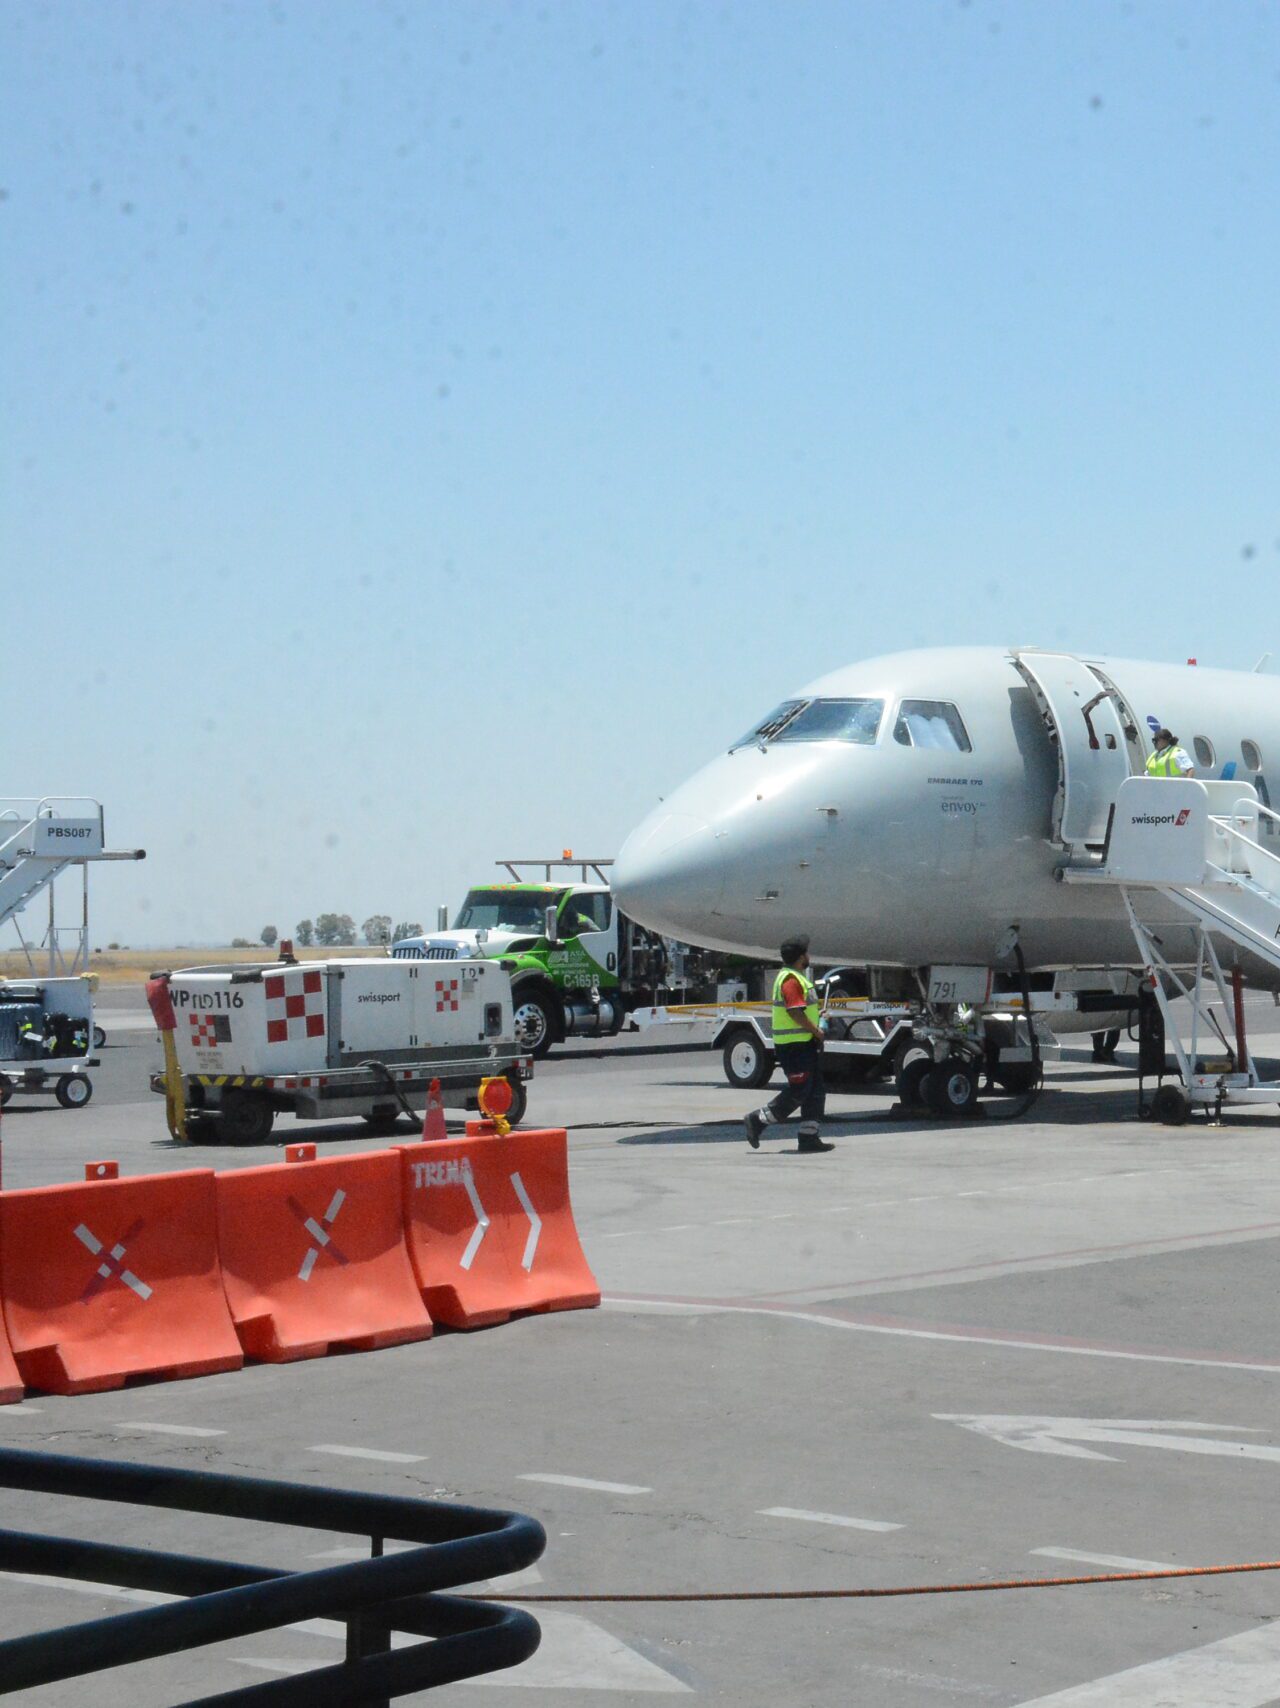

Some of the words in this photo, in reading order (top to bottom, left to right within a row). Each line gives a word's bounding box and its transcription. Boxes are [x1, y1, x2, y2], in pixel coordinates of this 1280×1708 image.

[942, 802, 977, 815] envoy
[1131, 812, 1175, 827] swissport
[47, 827, 92, 838] PBS087
[934, 982, 957, 999] 791
[358, 992, 401, 1005] swissport
